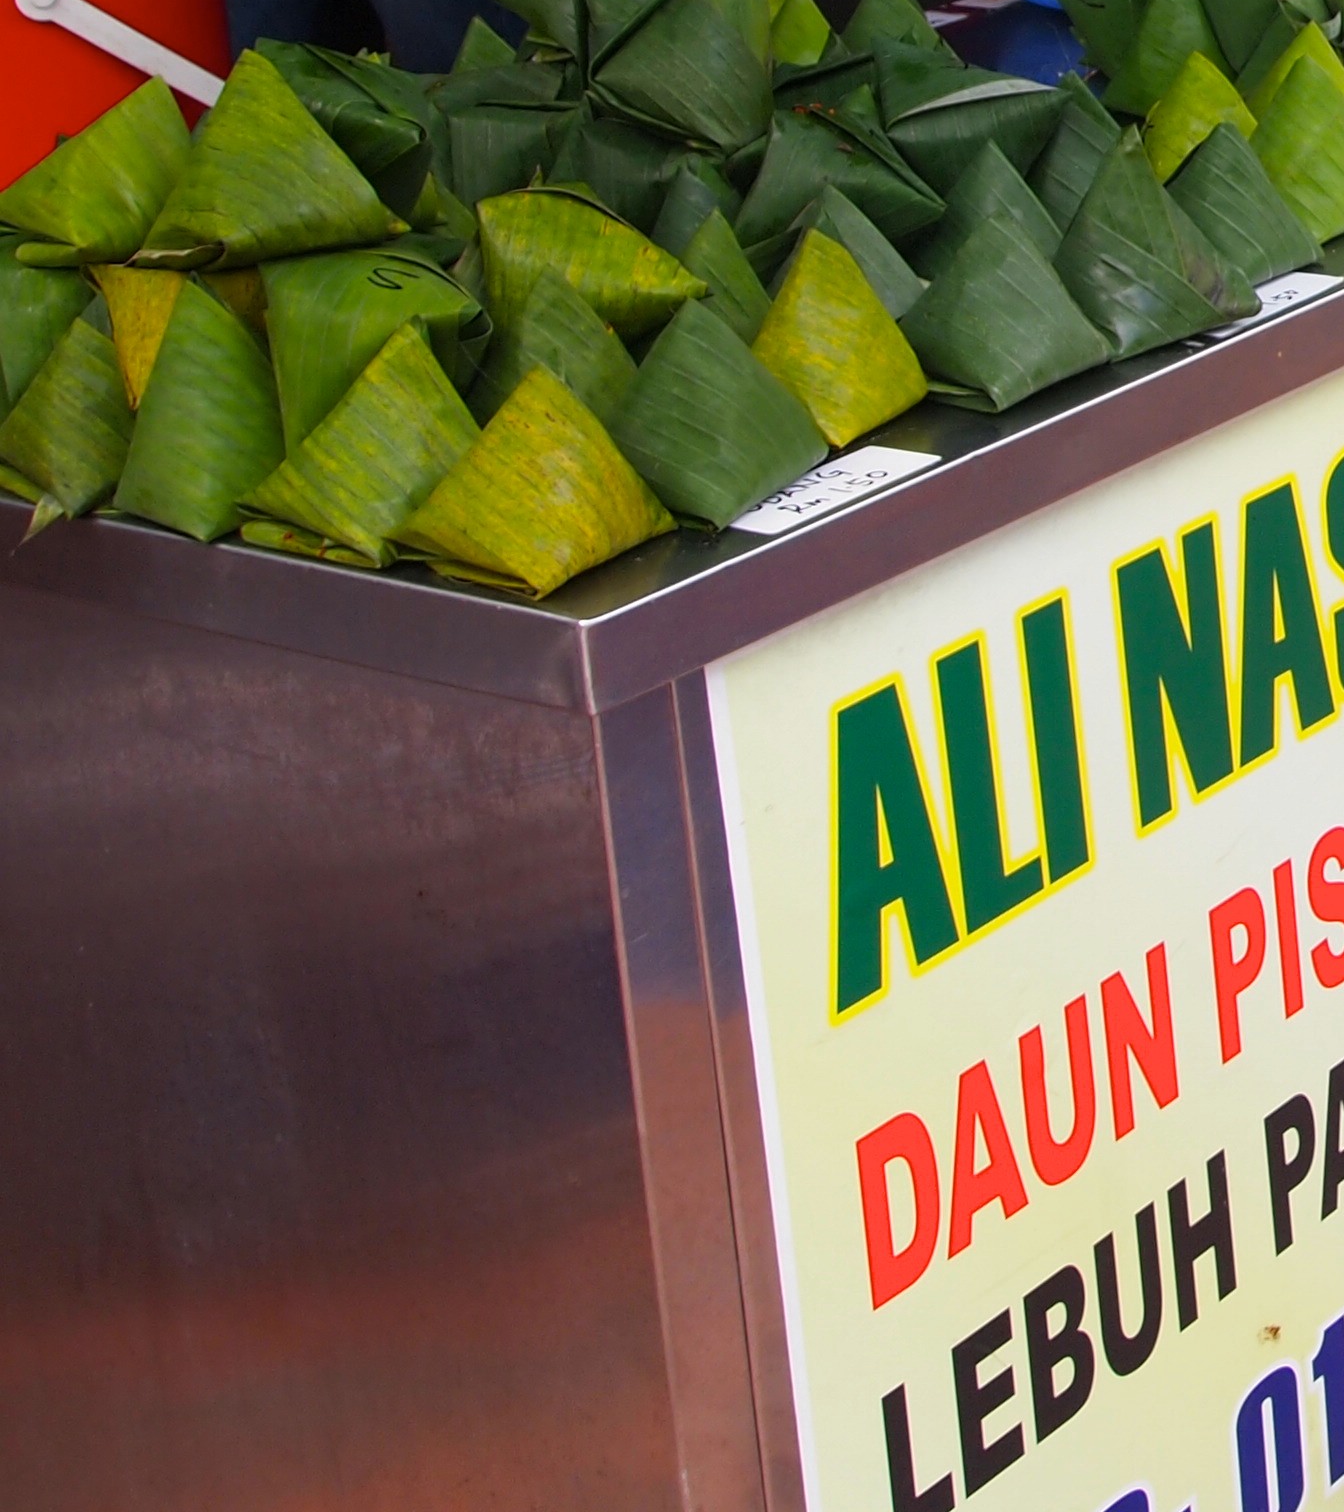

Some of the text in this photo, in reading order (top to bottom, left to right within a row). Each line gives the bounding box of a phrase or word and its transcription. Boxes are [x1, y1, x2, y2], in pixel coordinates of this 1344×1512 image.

[832, 585, 1092, 1026] ALI
[856, 943, 1178, 1309] DAUN
[881, 1151, 1236, 1512] LEBUH
